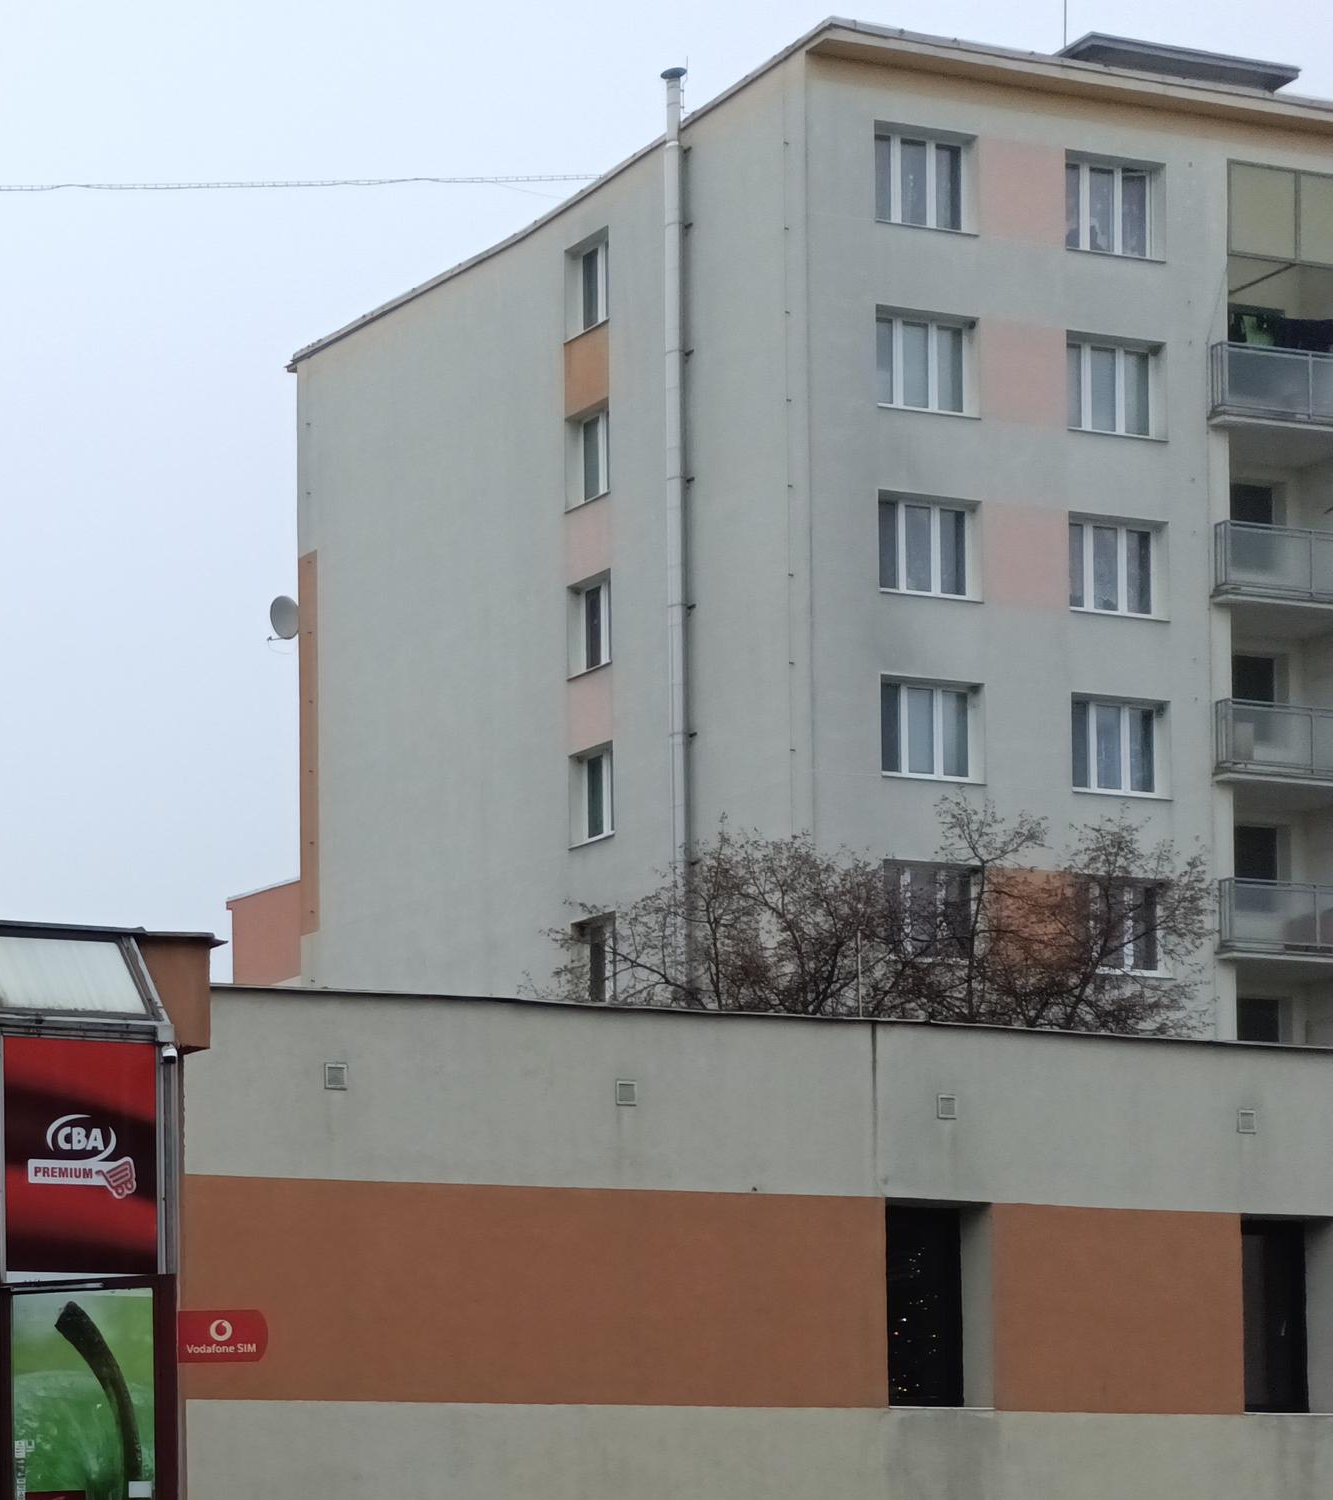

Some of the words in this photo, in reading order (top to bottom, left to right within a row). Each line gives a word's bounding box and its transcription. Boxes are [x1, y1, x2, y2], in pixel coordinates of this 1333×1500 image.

[58, 1127, 104, 1150] CBA
[34, 1166, 93, 1178] PREMIUM
[187, 1344, 235, 1353] Vodafone
[237, 1344, 256, 1352] SIM
